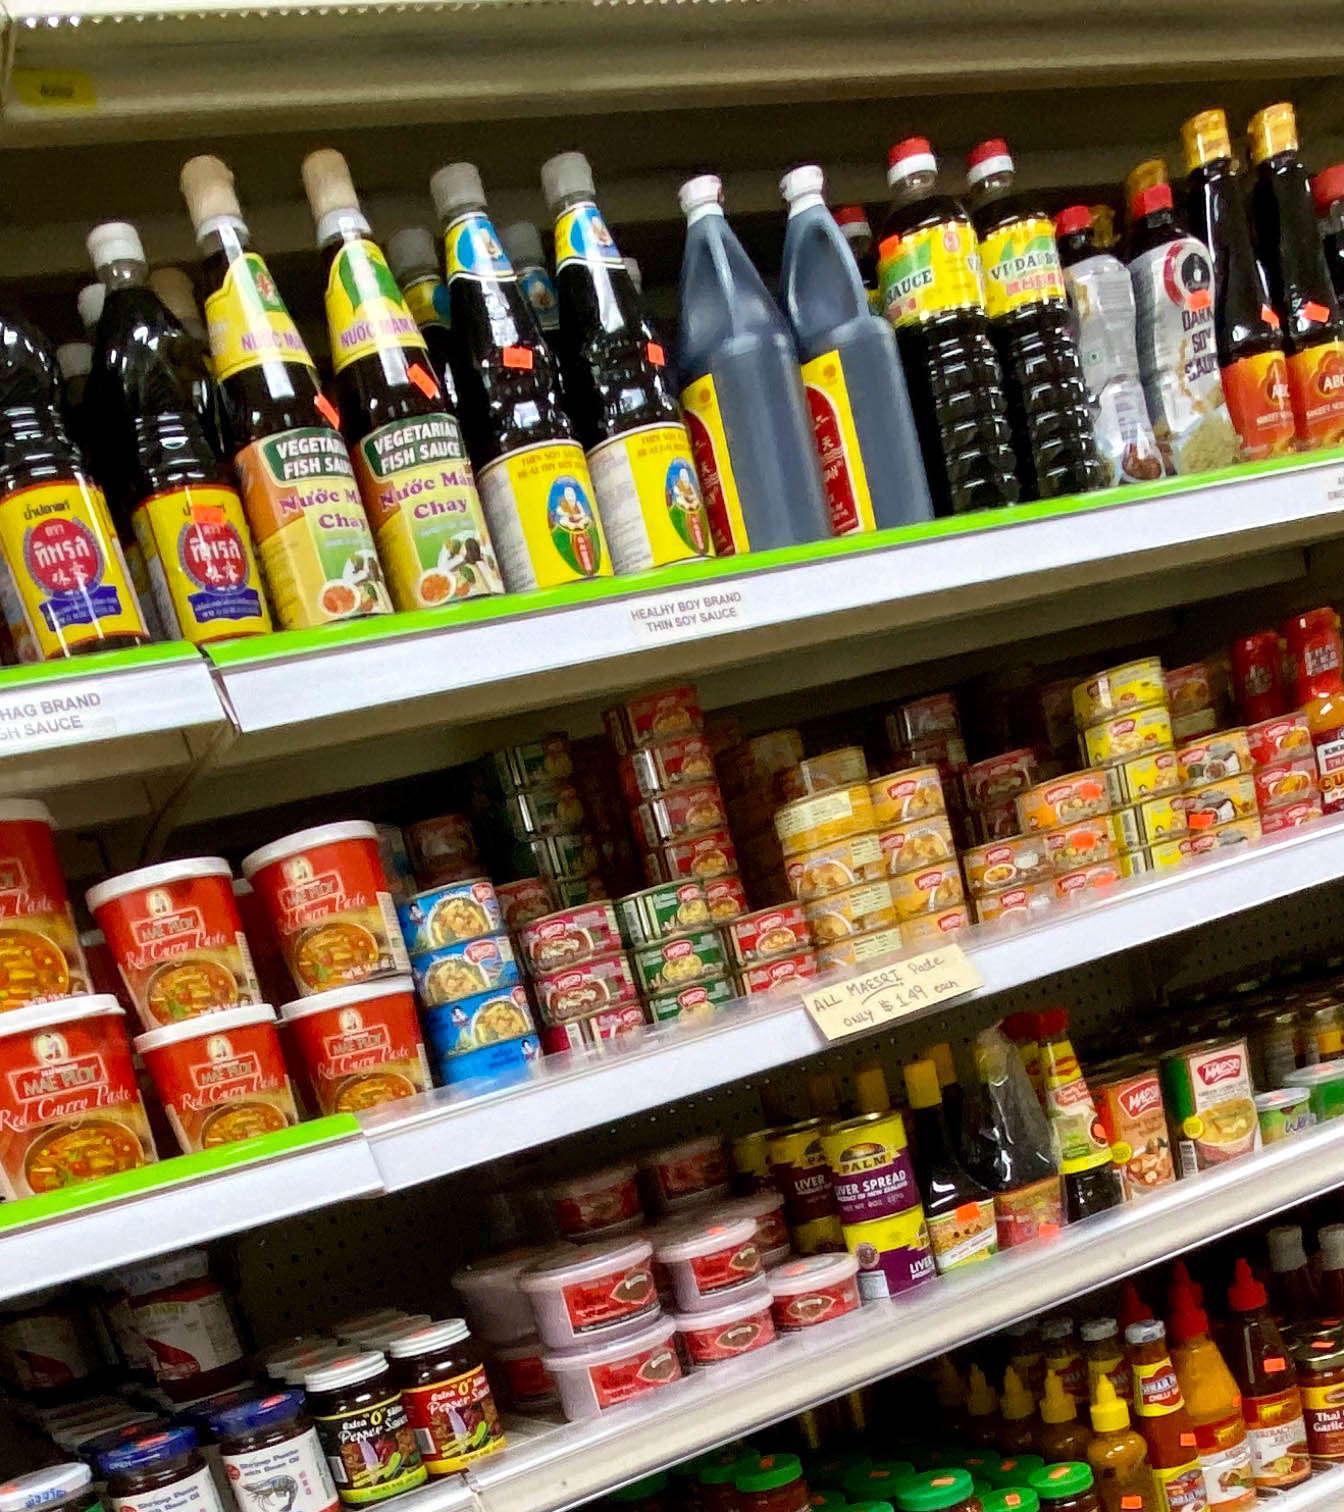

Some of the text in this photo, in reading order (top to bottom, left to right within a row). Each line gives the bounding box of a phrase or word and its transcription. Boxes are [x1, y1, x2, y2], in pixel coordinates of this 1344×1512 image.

[276, 435, 348, 459] VEGETAR
[283, 457, 325, 479] FISH
[380, 441, 462, 476] FISH SAUCE
[413, 499, 468, 520] Chay
[678, 599, 701, 613] BOY
[646, 606, 738, 633] THIN SOY SAUCE
[40, 692, 102, 720] BRAND
[24, 716, 85, 739] SAUCE
[813, 994, 843, 1012] ALL
[36, 1095, 90, 1129] Curry
[96, 1086, 132, 1107] Paste
[842, 1155, 887, 1173] PALM
[795, 1174, 825, 1191] LIVER
[836, 1170, 906, 1197] IVER SPREAD
[427, 1396, 471, 1415] Pepper
[1315, 1409, 1341, 1423] Thai
[337, 1425, 383, 1444] Pepper
